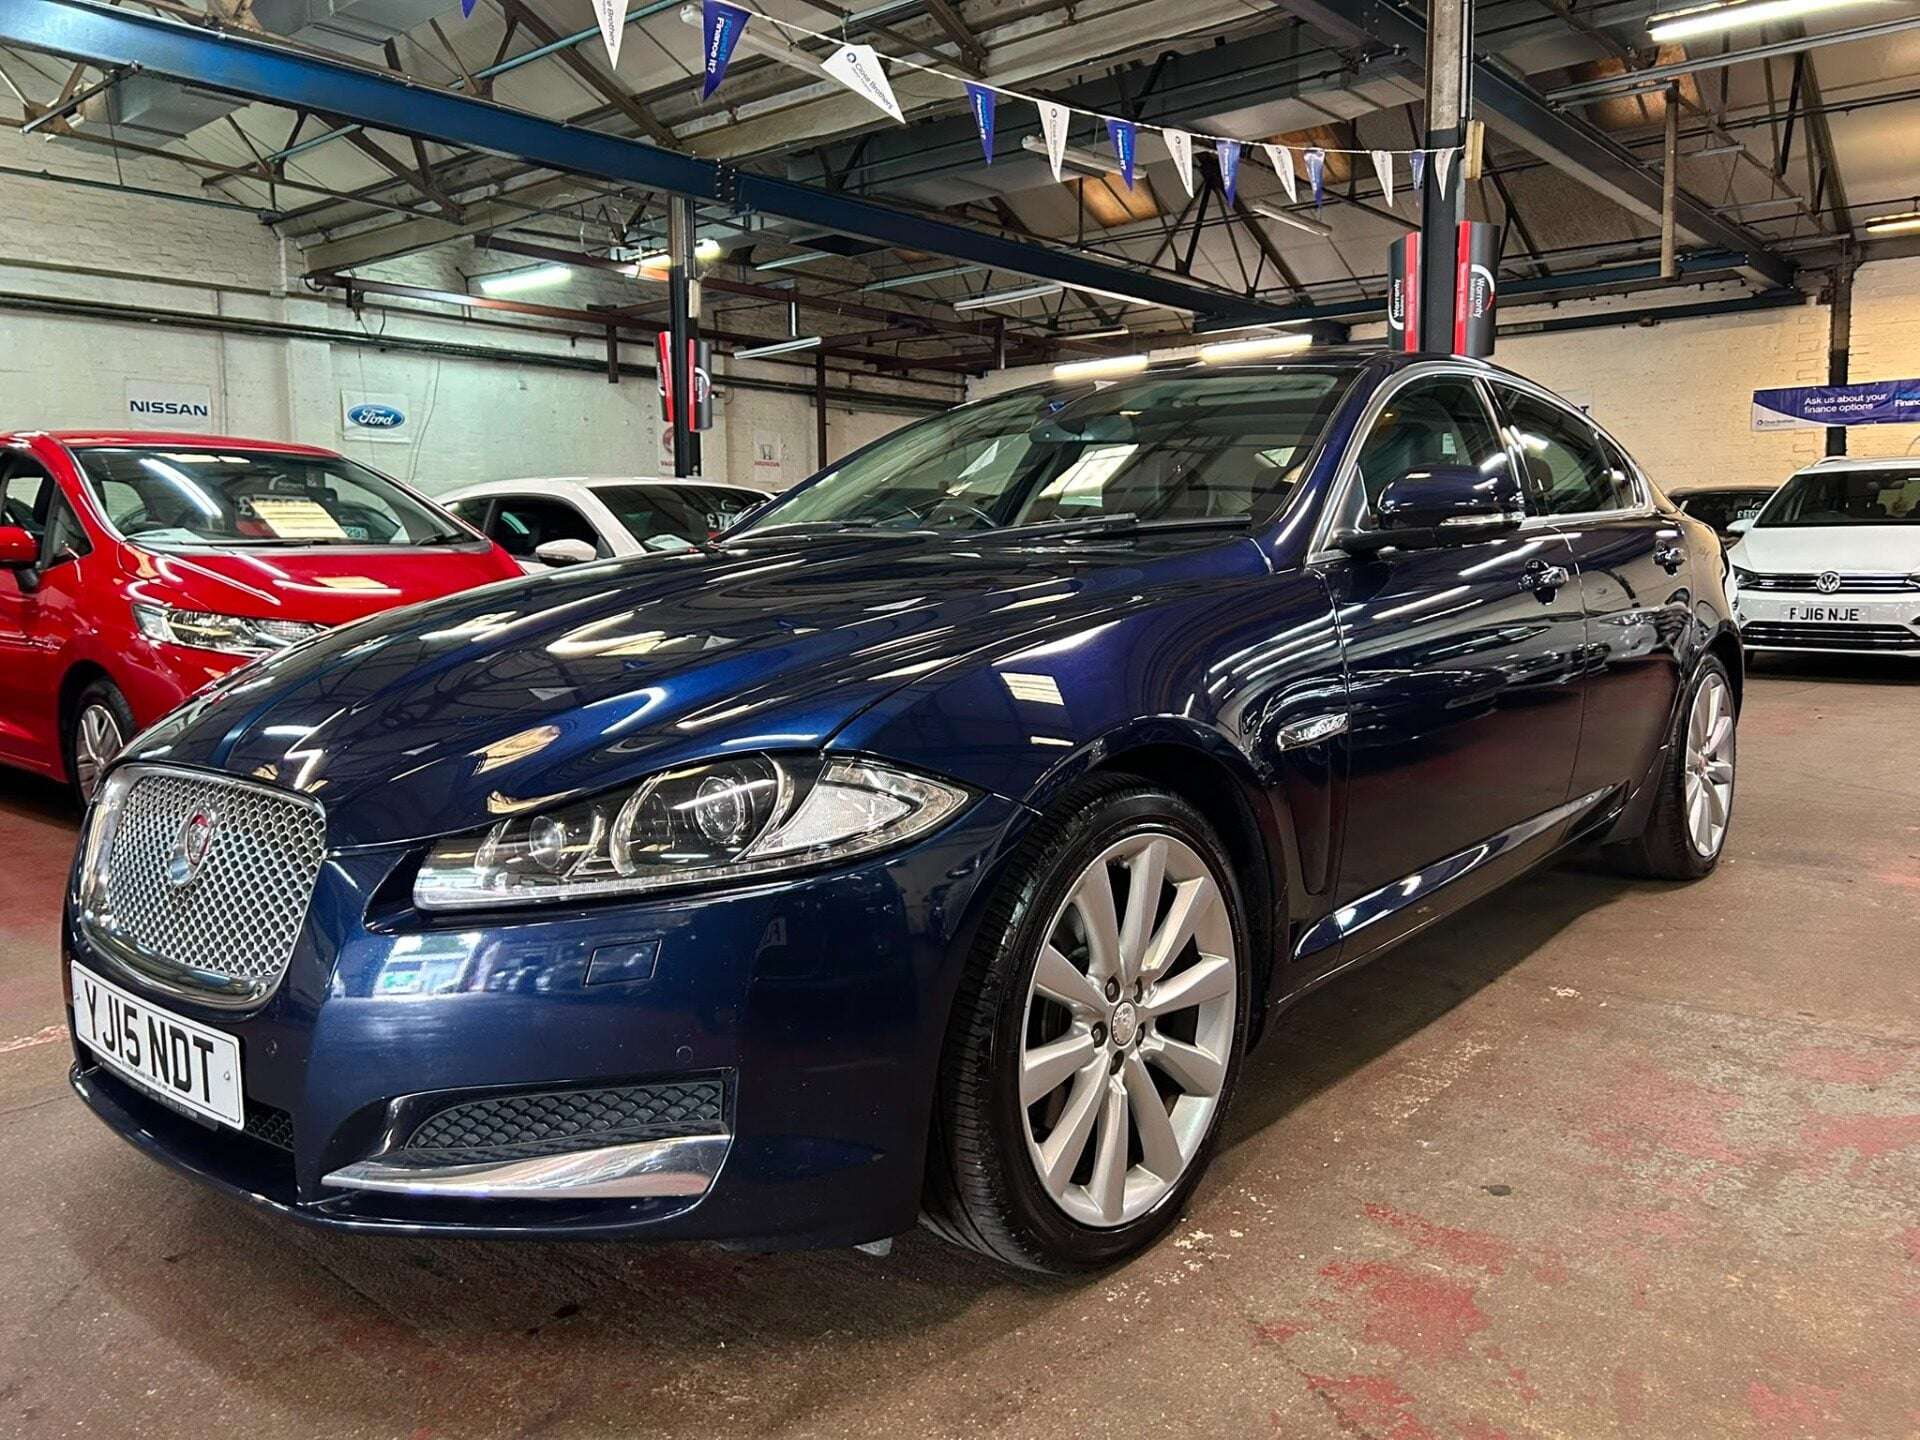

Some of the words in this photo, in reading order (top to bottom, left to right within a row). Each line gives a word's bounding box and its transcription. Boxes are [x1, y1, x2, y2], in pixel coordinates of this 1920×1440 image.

[710, 17, 725, 58] Finance
[1473, 277, 1485, 319] Warranty
[1804, 397, 1822, 405] Ask
[1824, 396, 1835, 404] us
[1837, 394, 1864, 403] about
[1866, 393, 1888, 403] your
[130, 400, 208, 417] NISSAN
[1804, 405, 1838, 414] finance
[1838, 403, 1874, 413] options
[359, 409, 395, 426] Ford
[1789, 607, 1825, 621] FJ16
[1828, 607, 1860, 622] NJE
[84, 979, 142, 1068] YJ15
[147, 1014, 215, 1104] NDT
